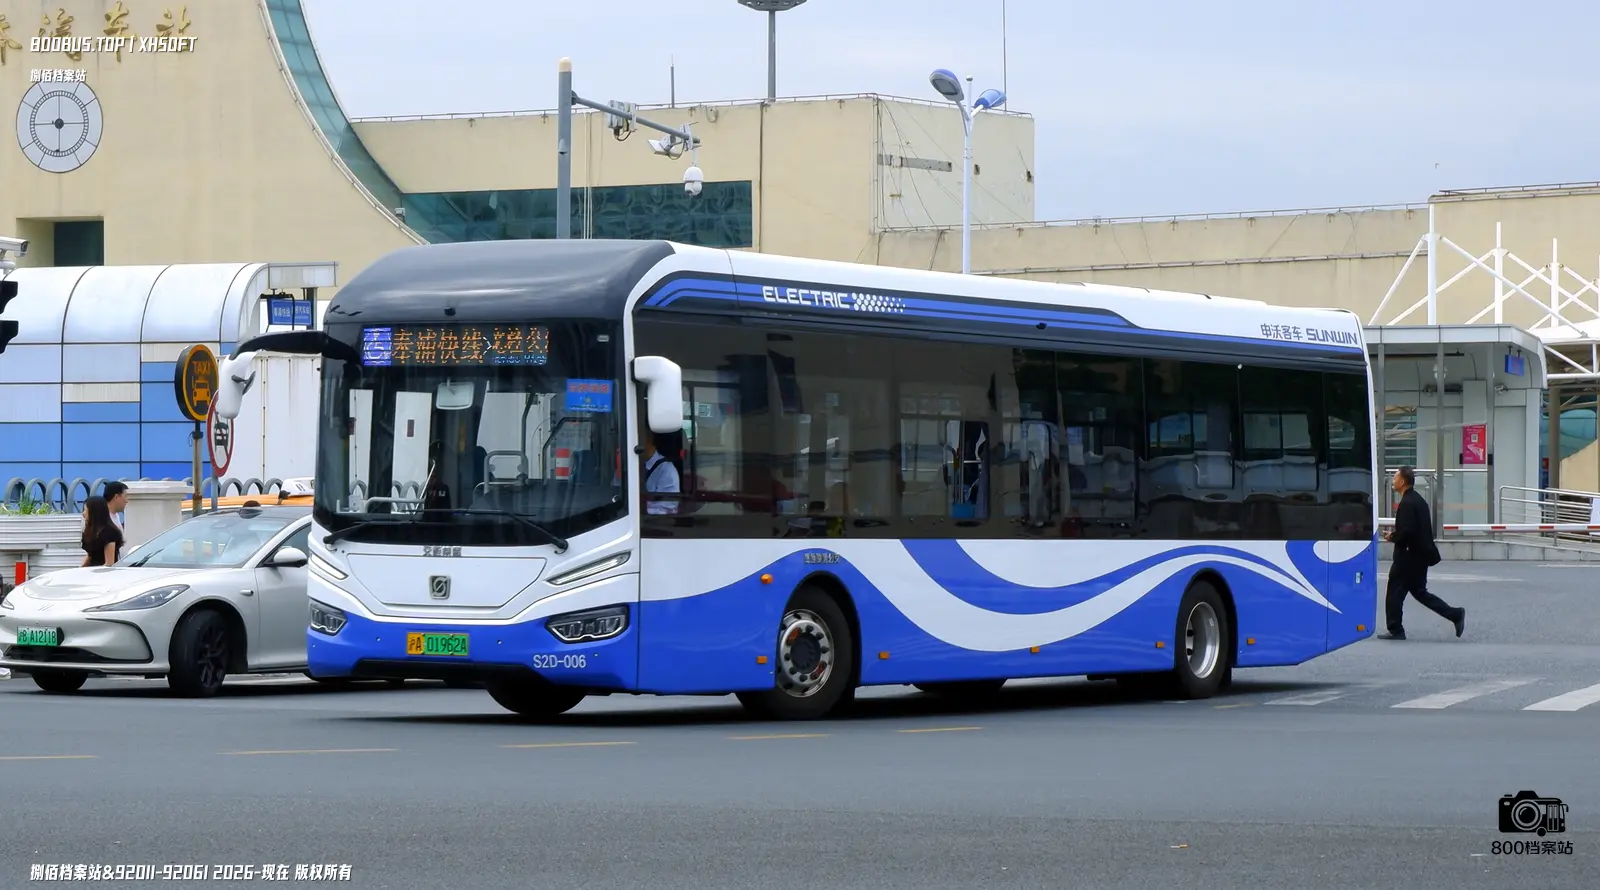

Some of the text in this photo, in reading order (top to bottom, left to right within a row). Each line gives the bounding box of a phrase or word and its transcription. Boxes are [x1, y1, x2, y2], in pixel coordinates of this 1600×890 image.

[762, 285, 850, 309] ELECTRIC
[1260, 323, 1358, 345] 申沃客车 SUNWIN
[392, 328, 483, 364] 奉浦快线
[192, 360, 211, 375] TAXI
[532, 654, 587, 669] S2D-006
